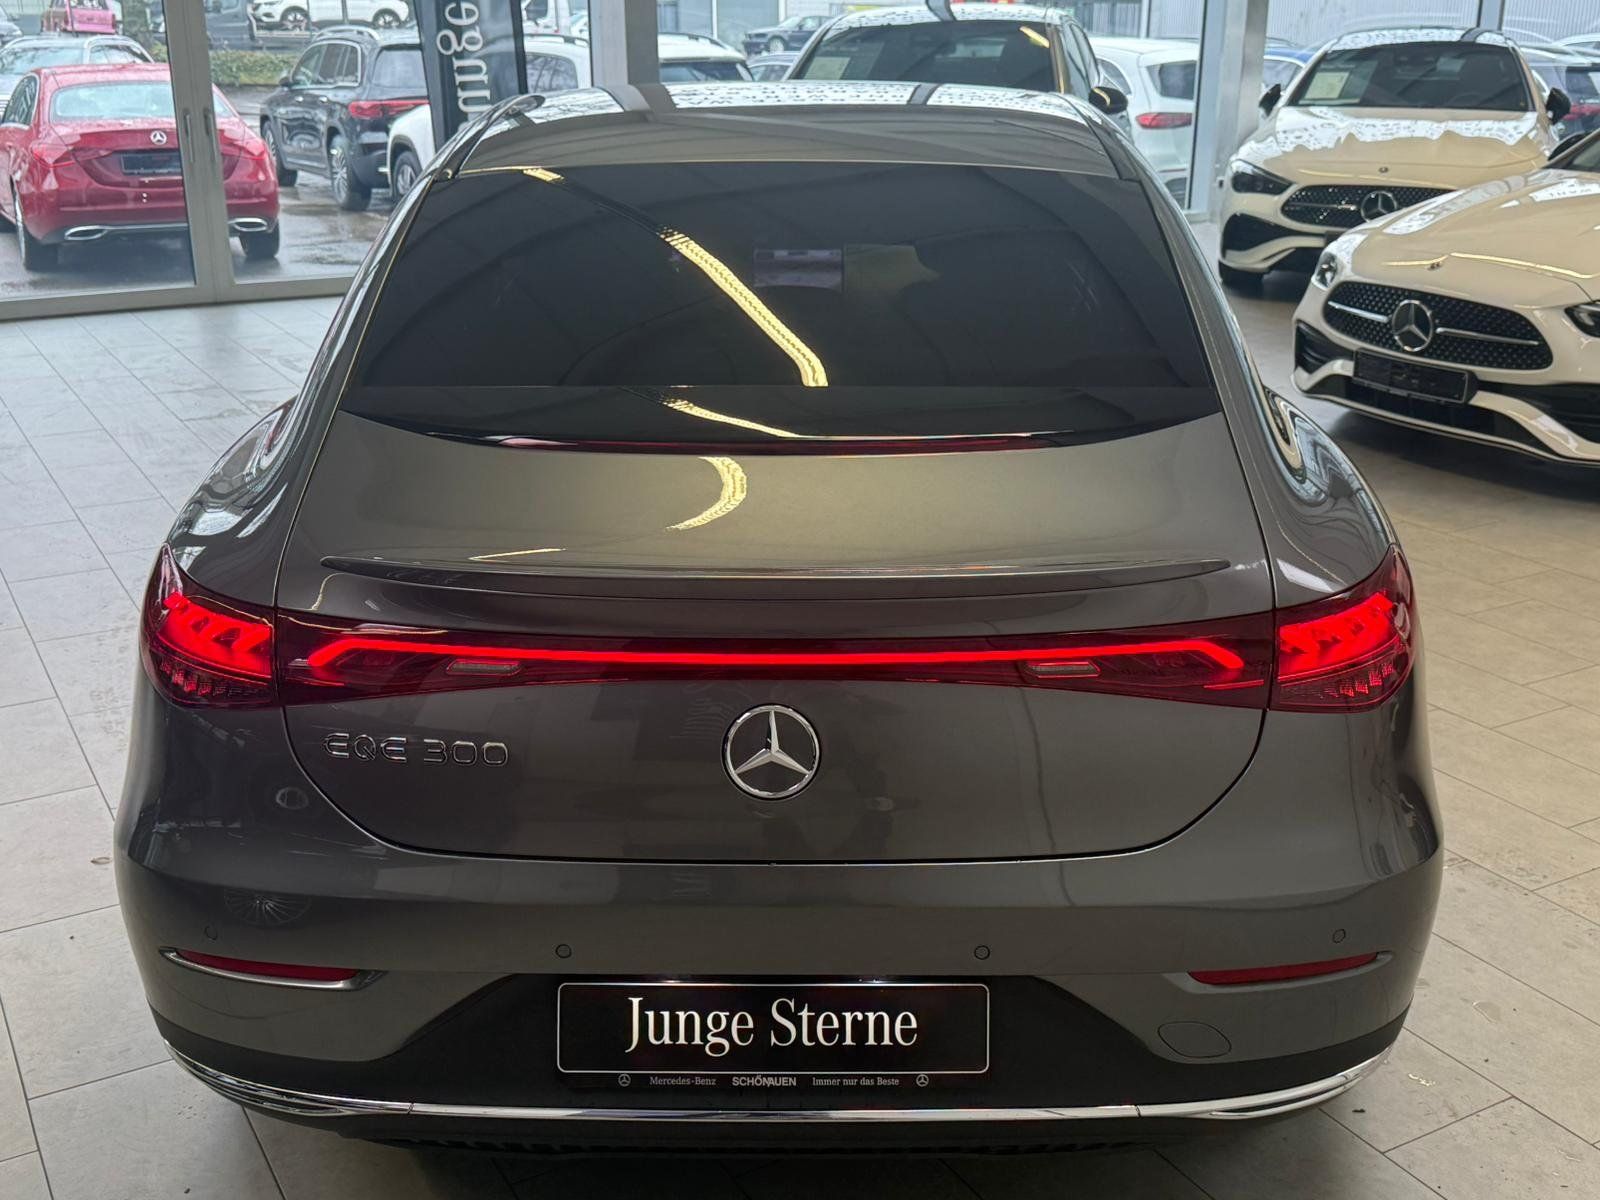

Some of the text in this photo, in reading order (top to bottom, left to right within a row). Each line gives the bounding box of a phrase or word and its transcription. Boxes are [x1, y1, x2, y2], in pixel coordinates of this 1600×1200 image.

[322, 731, 509, 767] EQE 300
[624, 996, 919, 1058] Junge Sterne
[649, 1075, 717, 1086] Mercedes-Benz
[731, 1074, 797, 1088] SCHÖNAUEN
[812, 1076, 900, 1087] Immer nur das Beste
